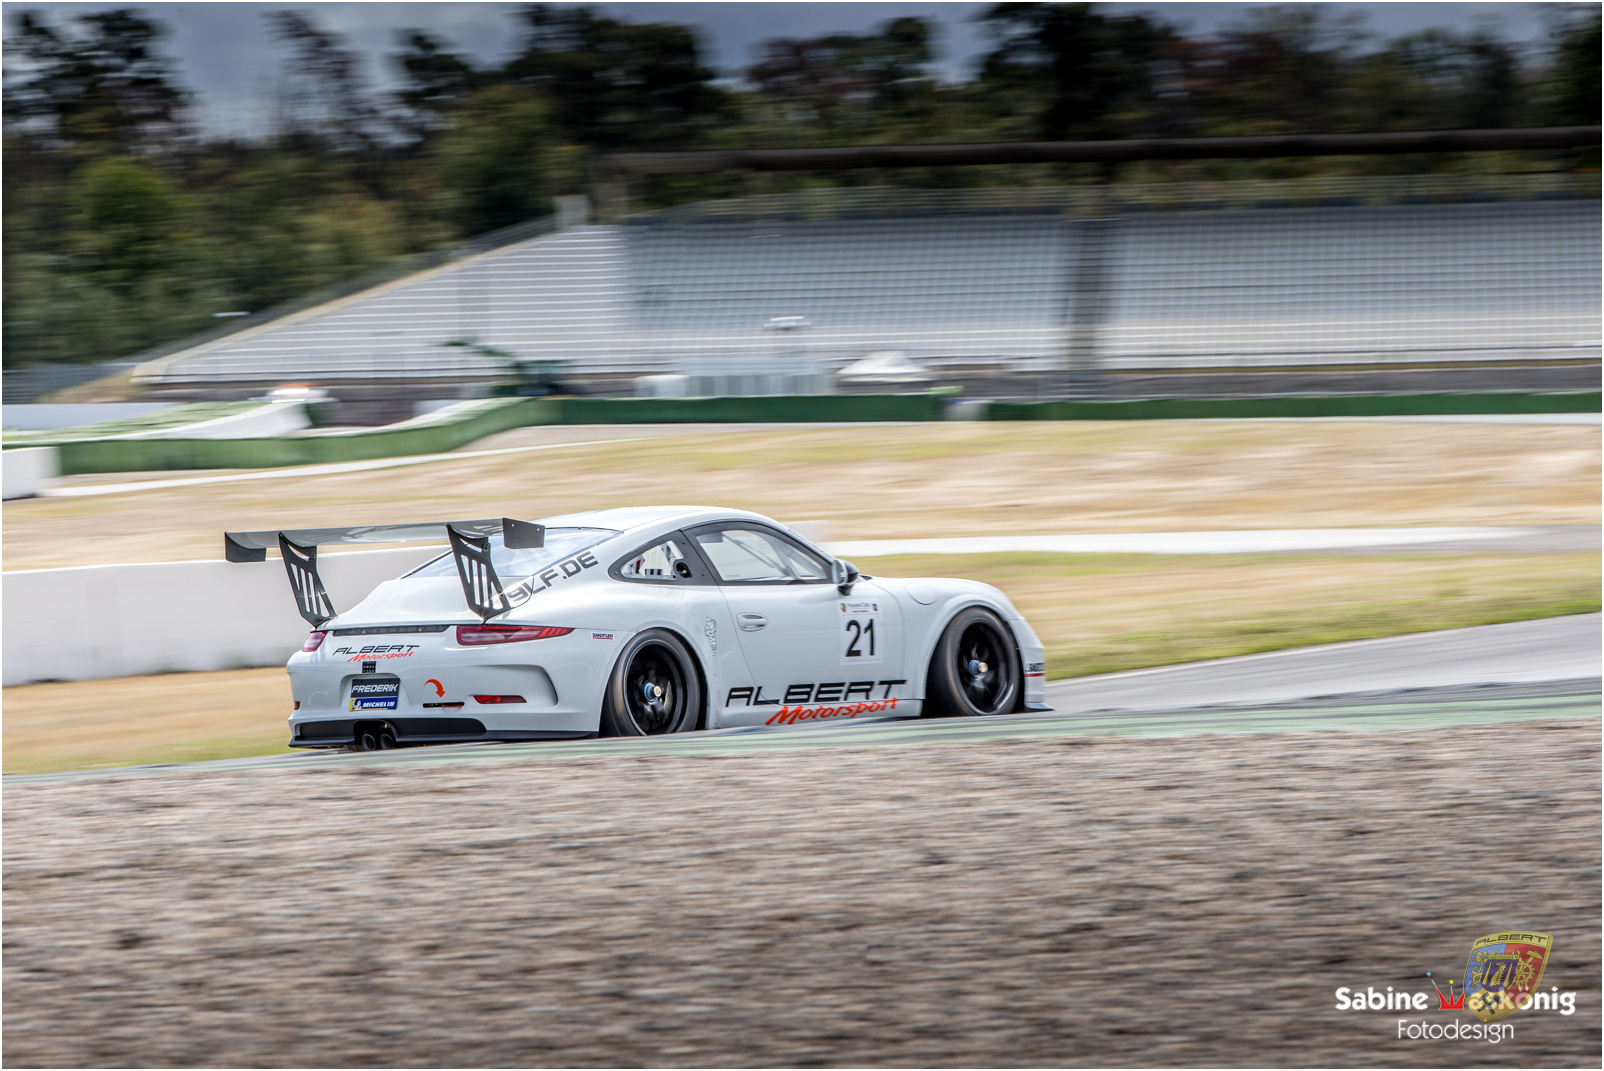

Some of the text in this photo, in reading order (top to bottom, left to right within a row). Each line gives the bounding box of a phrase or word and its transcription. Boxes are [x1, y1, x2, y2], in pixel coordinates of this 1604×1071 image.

[845, 618, 875, 657] 21
[332, 644, 421, 656] ALBERT
[347, 651, 414, 662] Motorsport
[351, 683, 399, 693] FREDERIK
[725, 679, 907, 708] ALBERT
[765, 697, 899, 726] Motorsport
